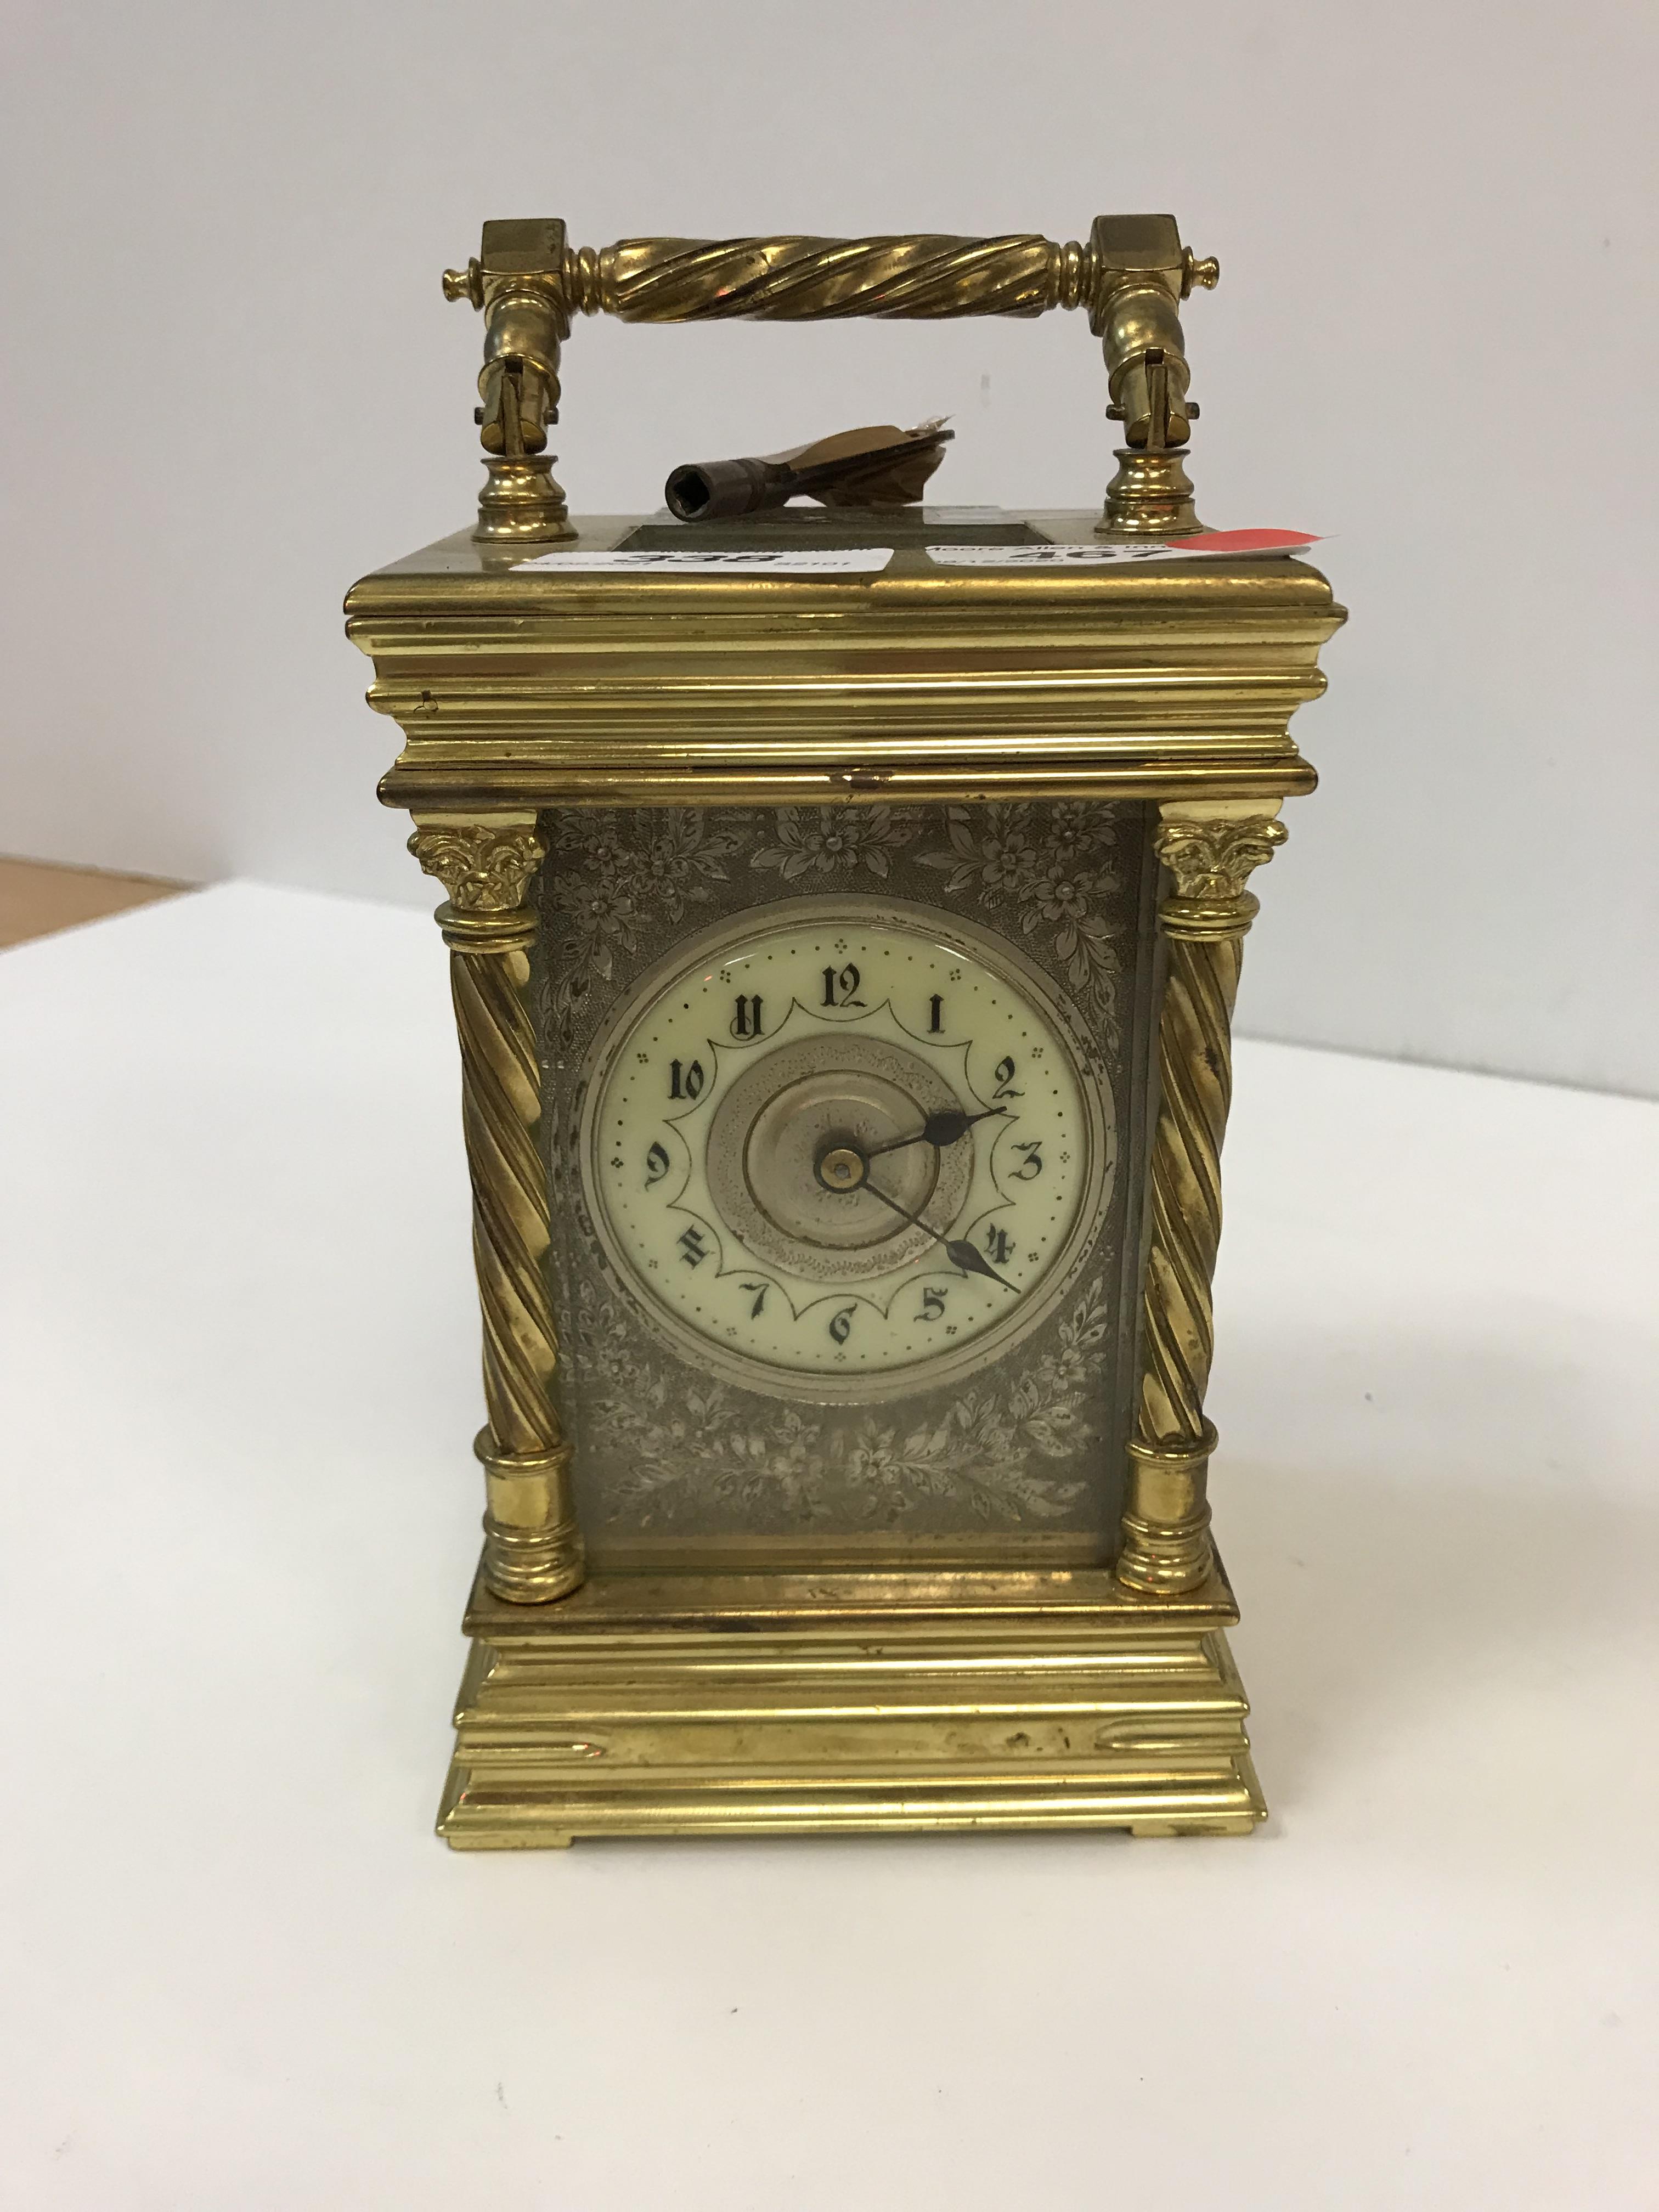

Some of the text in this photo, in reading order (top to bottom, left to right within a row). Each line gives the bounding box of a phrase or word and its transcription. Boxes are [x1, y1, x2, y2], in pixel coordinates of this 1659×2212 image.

[1008, 550, 1172, 559] 467
[820, 963, 866, 1007] 12
[730, 994, 765, 1041] 11
[927, 994, 945, 1034] 1
[667, 1059, 704, 1101] 10
[992, 1055, 1025, 1100] 2
[646, 1142, 670, 1190] 9
[1008, 1141, 1043, 1181] 3
[680, 1224, 716, 1268] 8
[985, 1223, 1017, 1265] 4
[740, 1283, 769, 1319] 7
[914, 1287, 949, 1322] 5
[829, 1303, 857, 1345] 6
